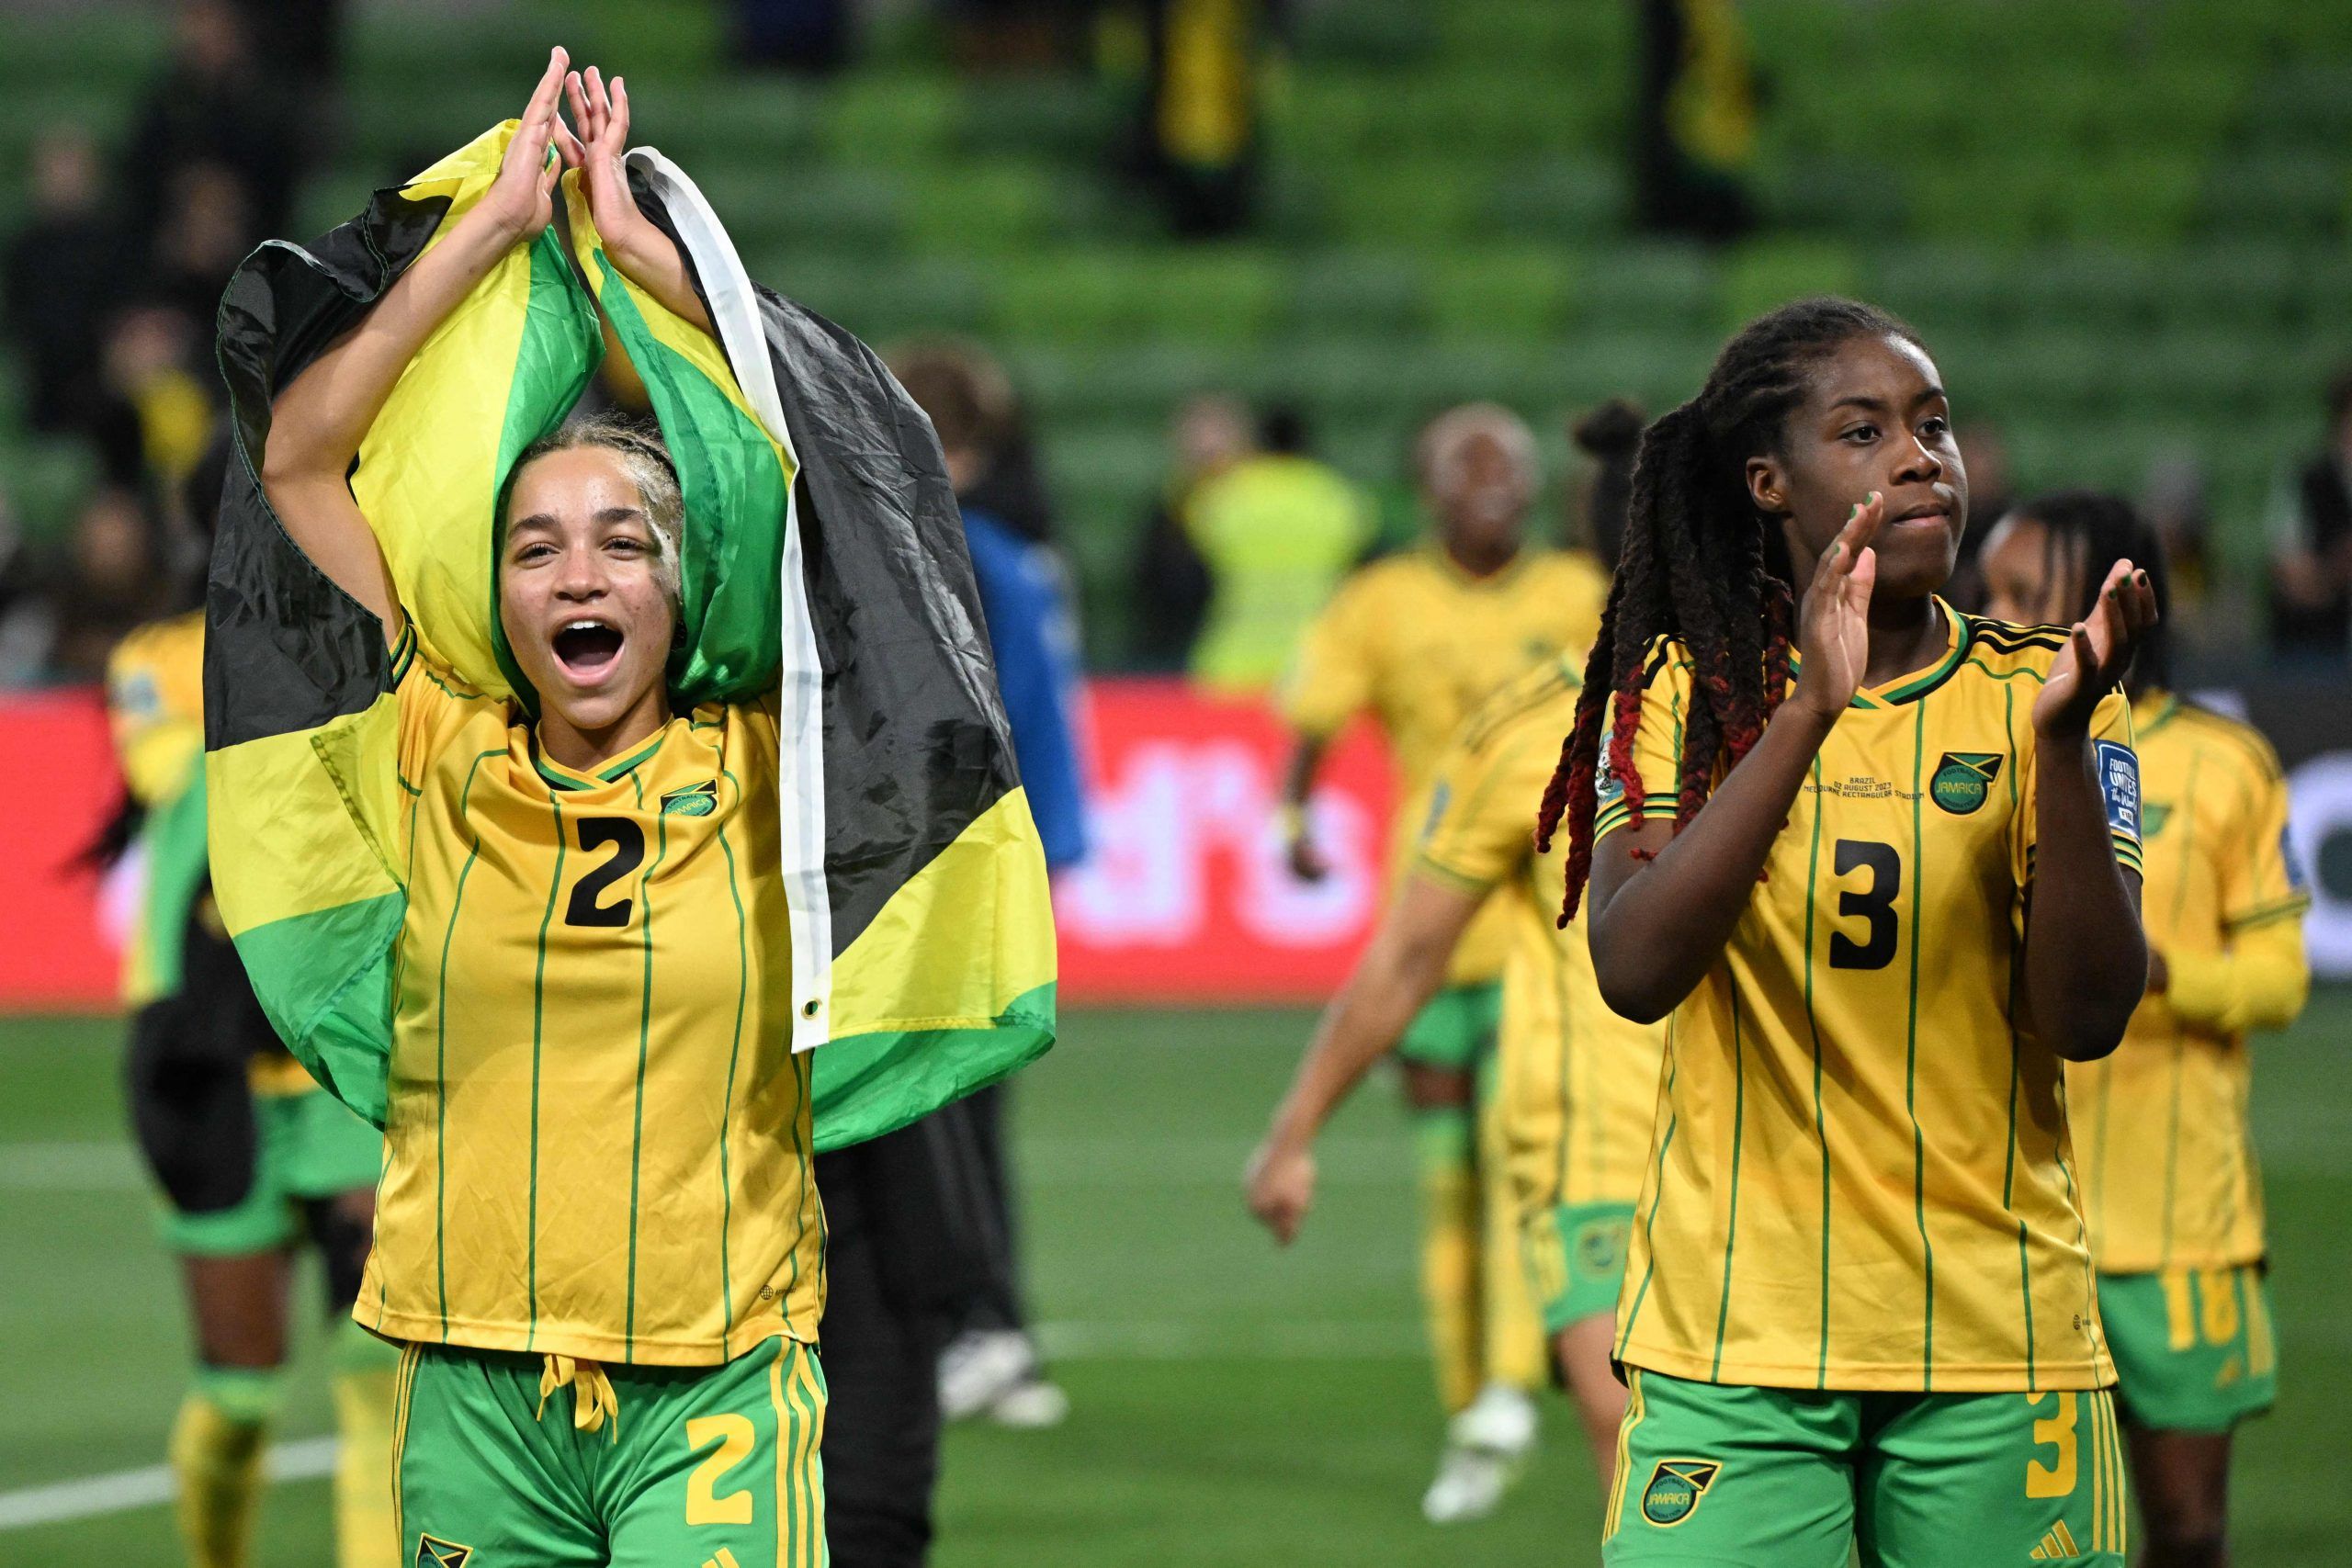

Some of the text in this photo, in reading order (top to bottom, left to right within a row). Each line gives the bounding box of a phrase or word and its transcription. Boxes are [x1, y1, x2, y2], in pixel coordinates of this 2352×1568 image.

[1804, 784, 1925, 800] MELBOURNE RECTANGULAR STADIUM
[1834, 781, 1842, 790] 02
[1875, 782, 1892, 791] 2023
[1935, 781, 1982, 795] JAMAICA
[672, 797, 710, 815] AMAICA
[565, 817, 645, 927] 2
[1829, 839, 1901, 970] 3
[2026, 1392, 2078, 1499] 3
[686, 1413, 755, 1526] 2
[1646, 1492, 1690, 1506] JAMAICA
